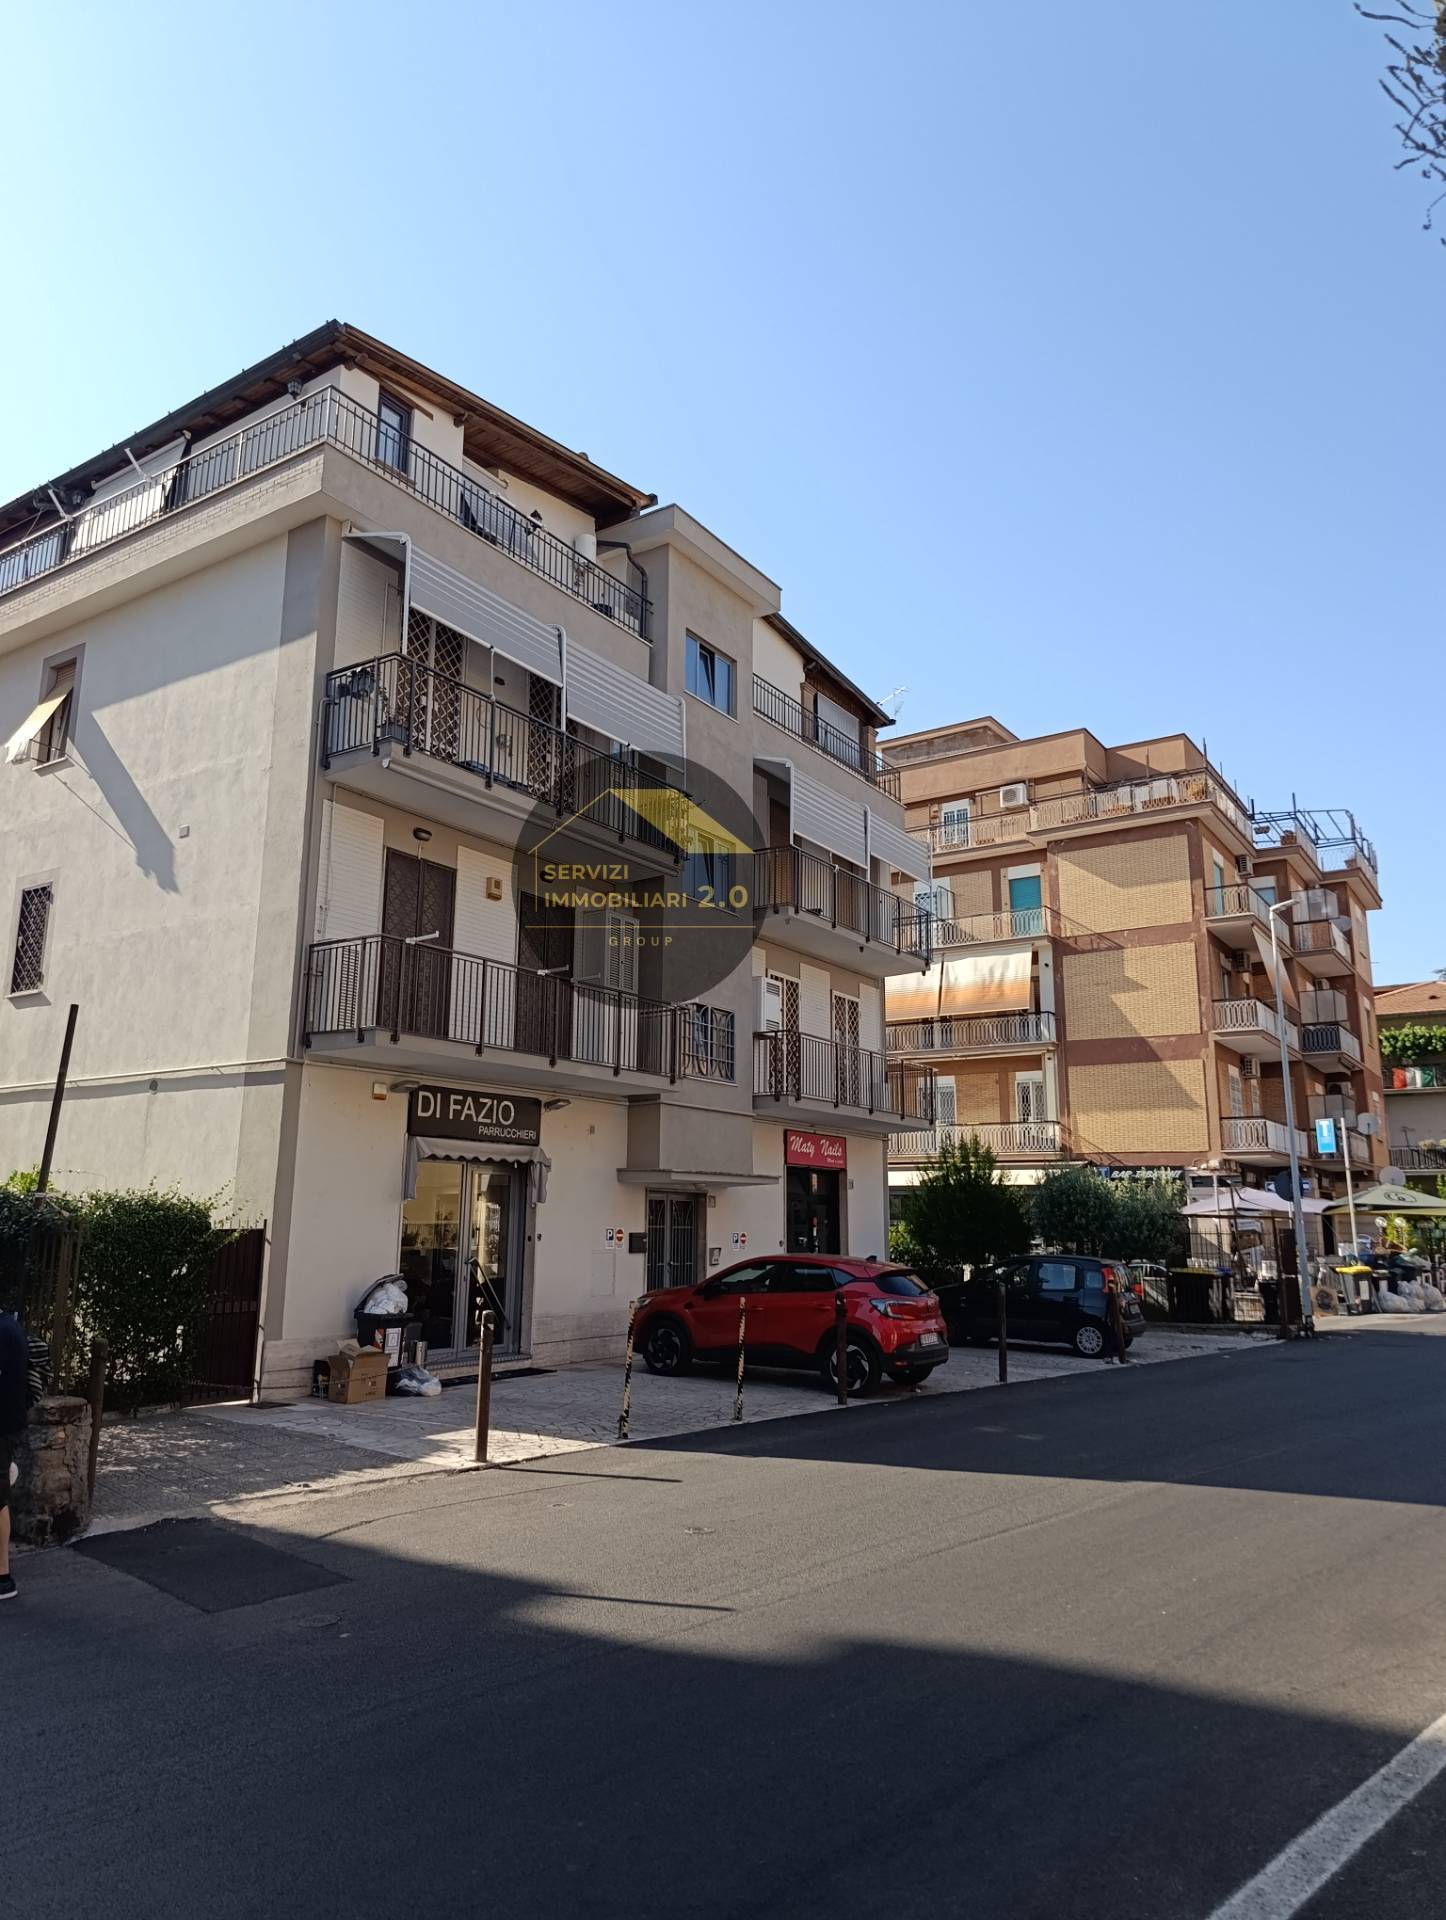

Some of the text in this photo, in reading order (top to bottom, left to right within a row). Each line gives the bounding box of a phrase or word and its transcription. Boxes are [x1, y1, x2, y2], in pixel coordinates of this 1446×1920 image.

[417, 1090, 515, 1126] DI FAZIO
[478, 1125, 537, 1140] PARRUCCHIERI
[790, 1135, 842, 1158] Maty Nails
